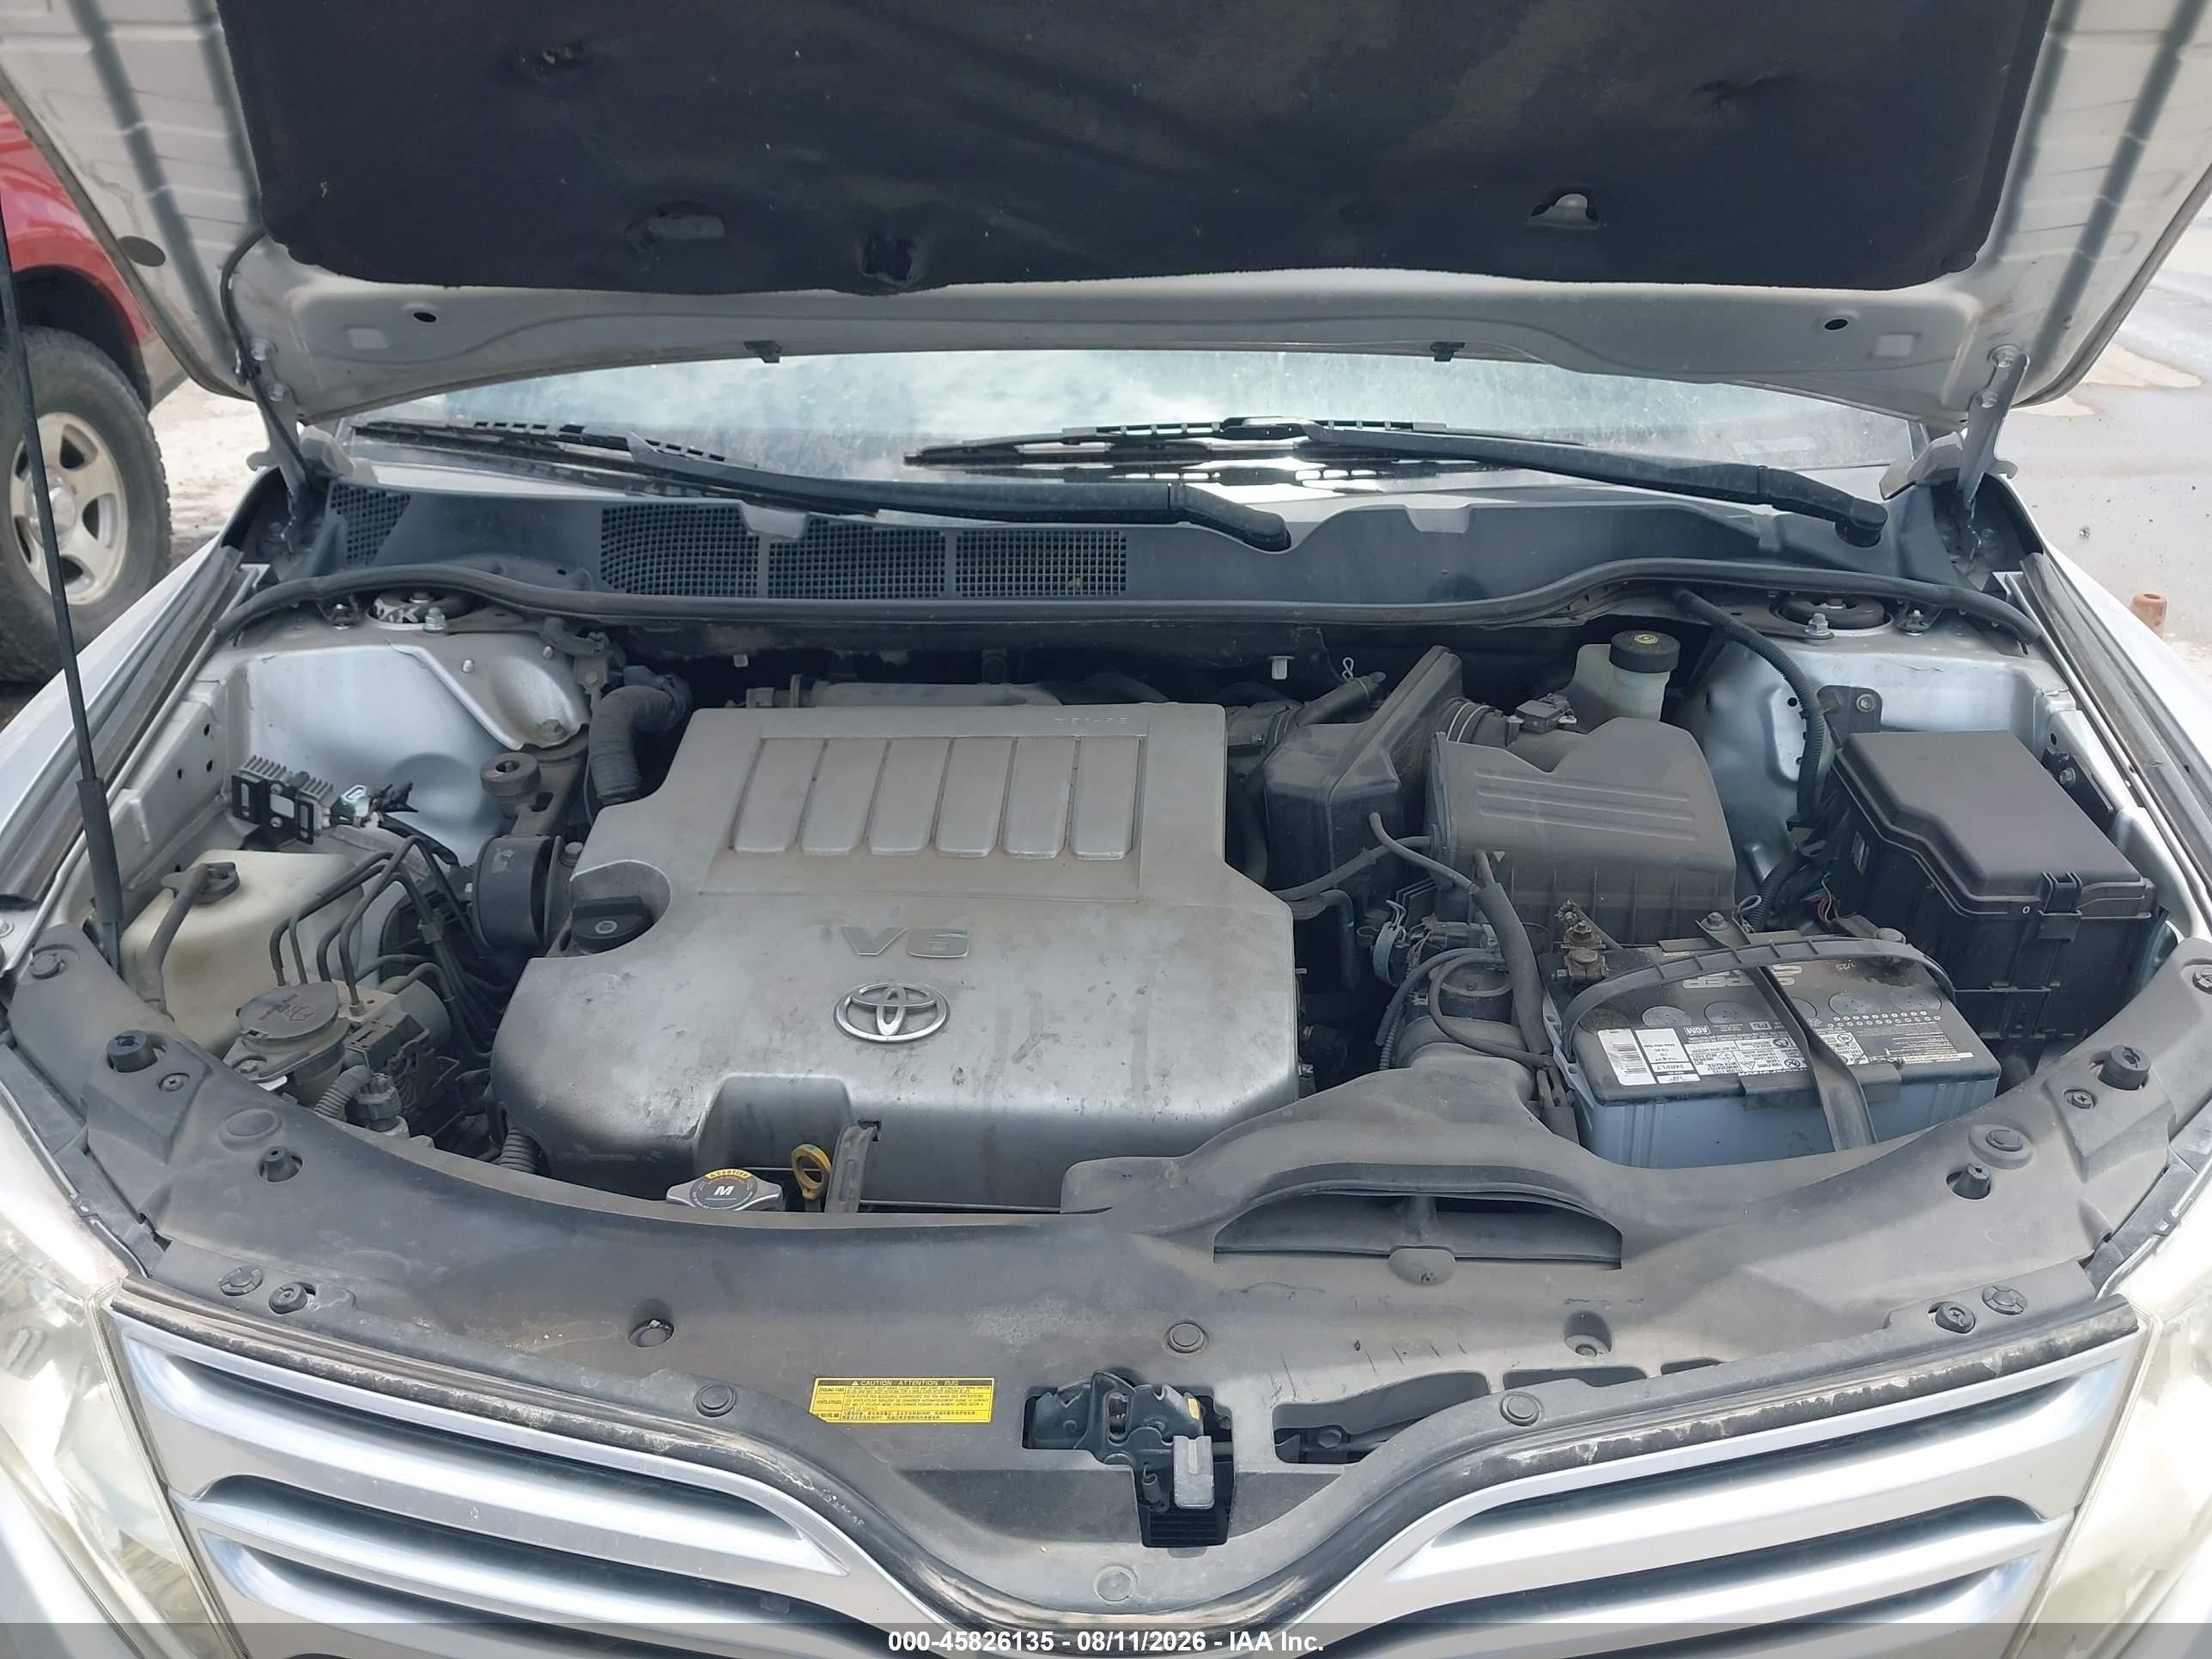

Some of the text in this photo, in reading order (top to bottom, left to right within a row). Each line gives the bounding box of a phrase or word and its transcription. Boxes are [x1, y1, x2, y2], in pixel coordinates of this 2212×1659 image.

[842, 927, 969, 958] V6
[1686, 1025, 1708, 1036] AGM
[714, 1185, 736, 1196] M
